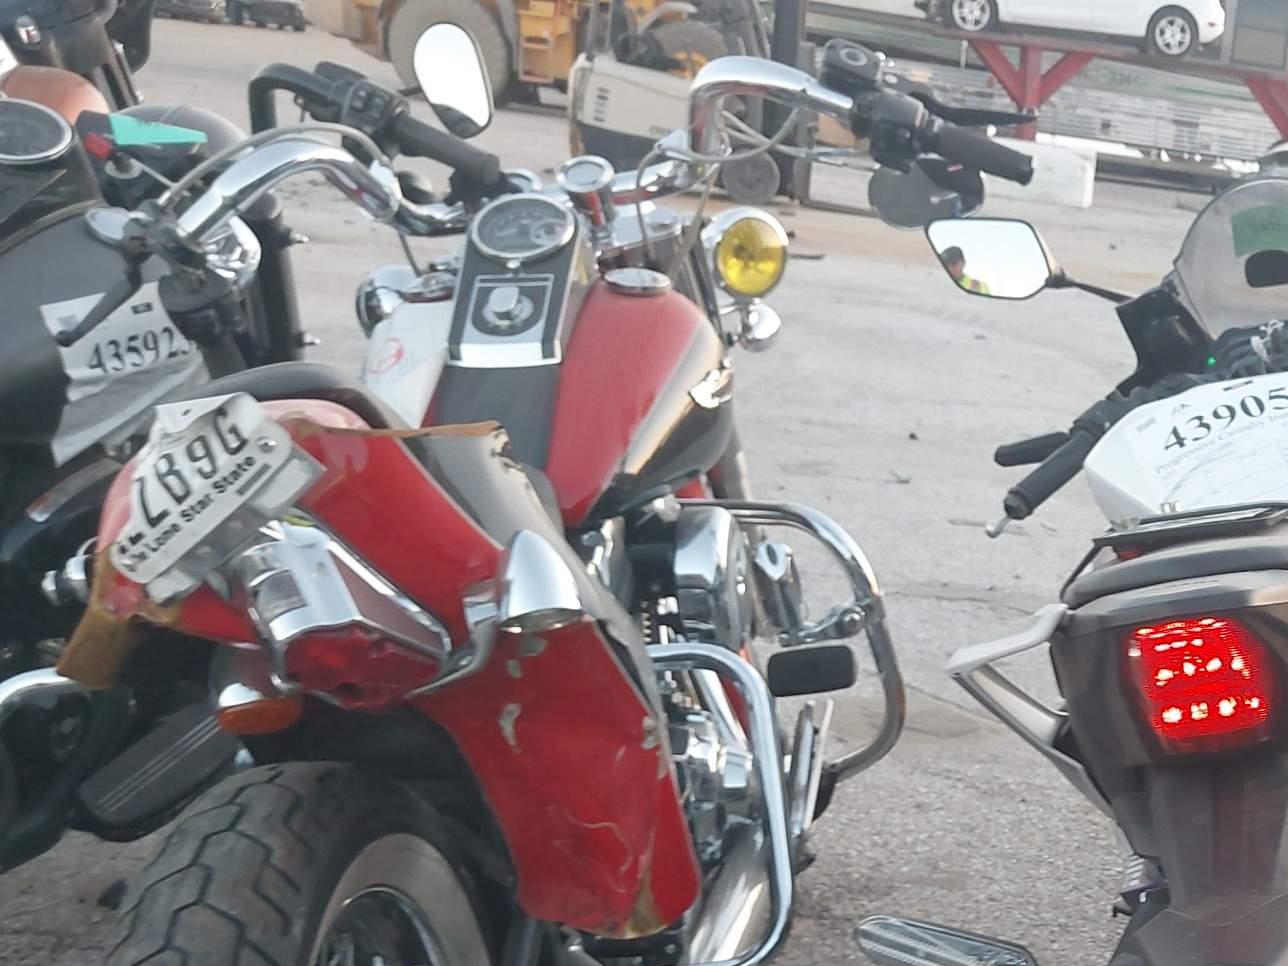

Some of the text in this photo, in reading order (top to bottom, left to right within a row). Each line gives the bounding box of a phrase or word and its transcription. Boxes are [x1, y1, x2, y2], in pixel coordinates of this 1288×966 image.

[88, 326, 189, 375] 43592
[146, 522, 182, 553] Lone
[180, 493, 214, 523] Star
[212, 456, 255, 494] State
